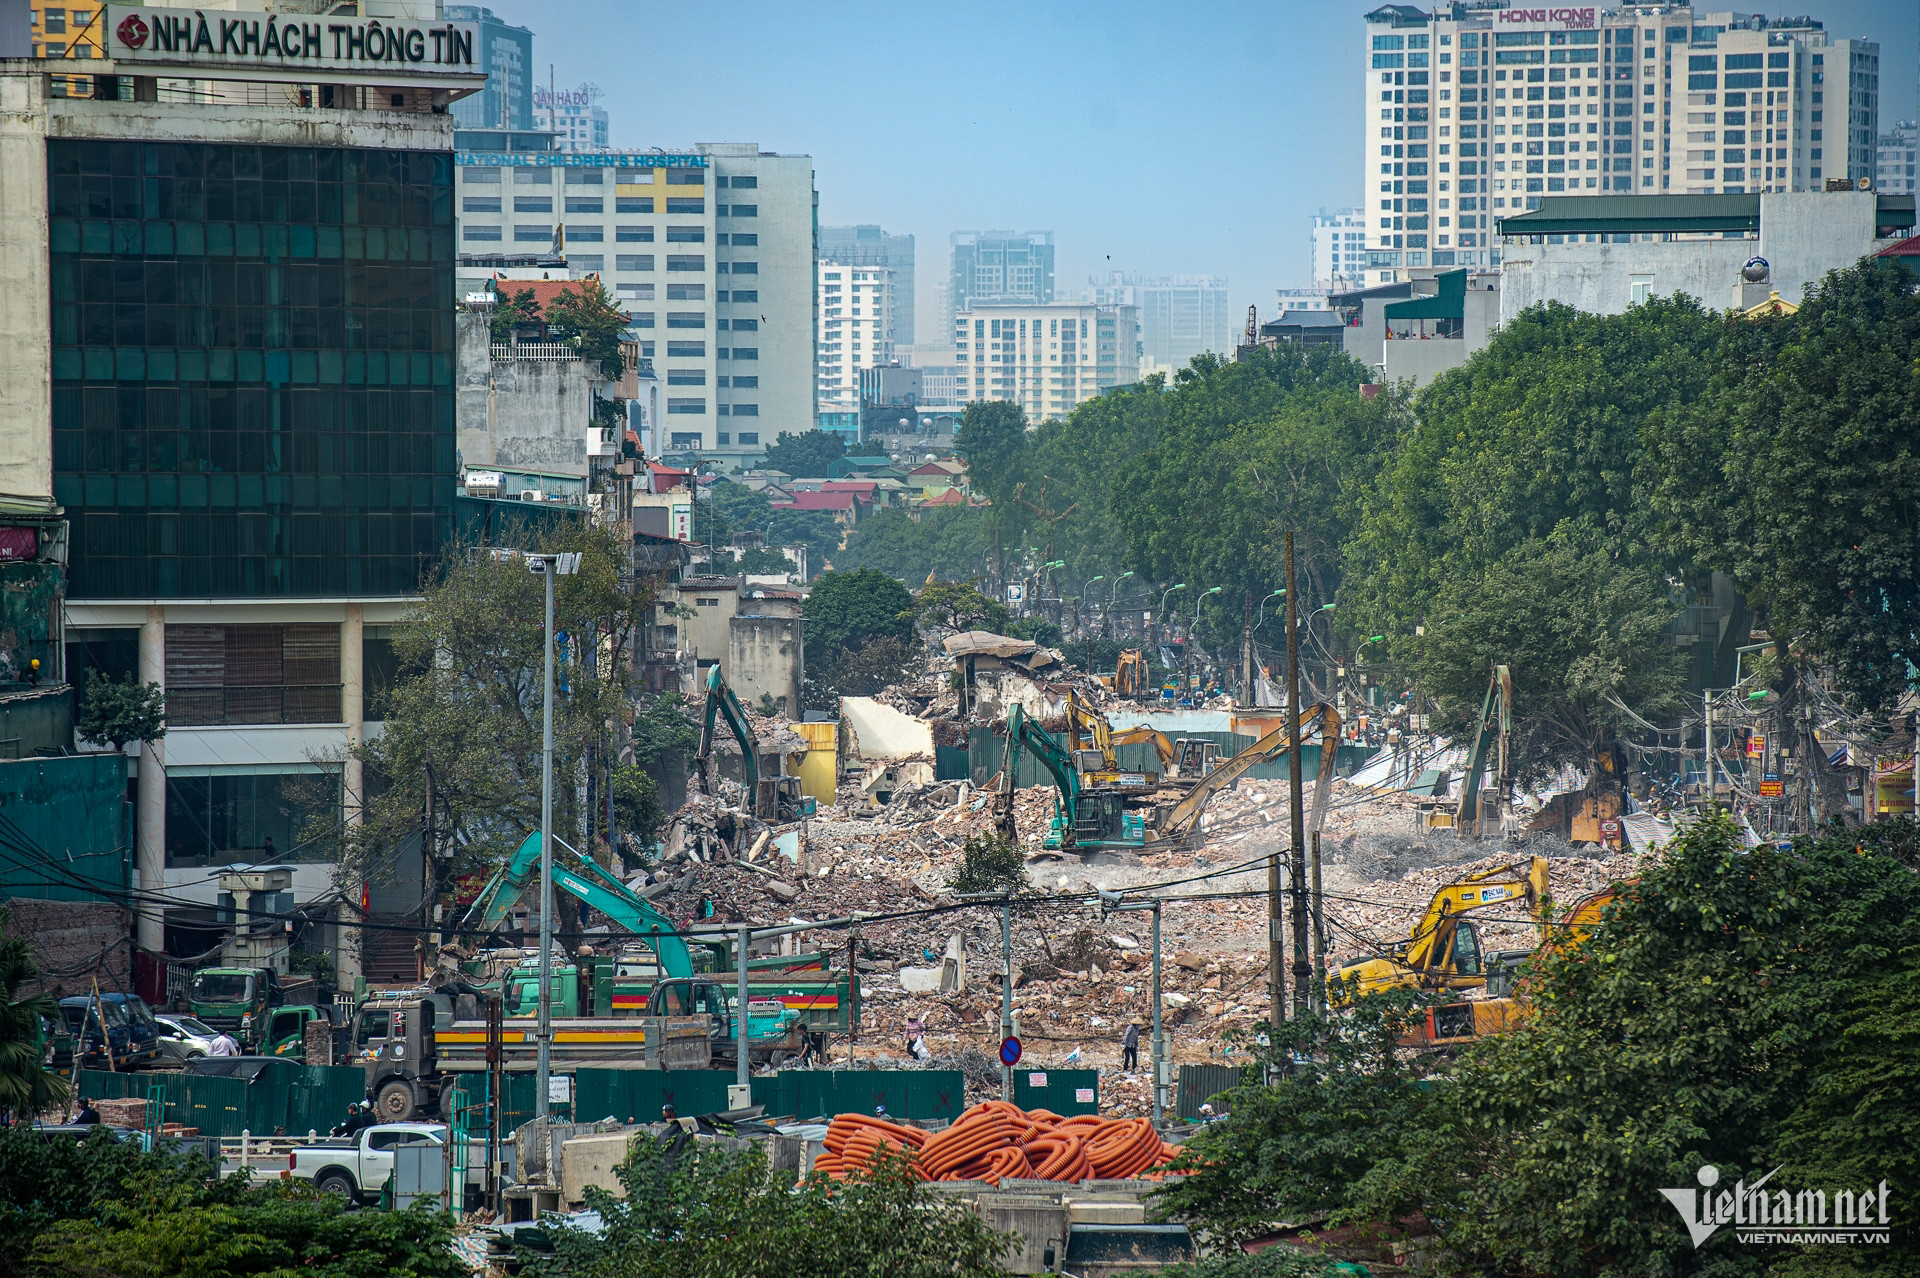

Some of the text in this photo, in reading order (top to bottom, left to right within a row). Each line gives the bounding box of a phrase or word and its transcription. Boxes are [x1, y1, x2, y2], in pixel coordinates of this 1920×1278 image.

[1499, 8, 1595, 23] HONG KONG
[1565, 21, 1595, 29] TOWER
[152, 9, 472, 64] NHÀ KHÁCH THÔNG TÍN
[557, 89, 571, 105] HÀ
[455, 152, 709, 168] NATIONAL CHILDREN'S HOSPITAL
